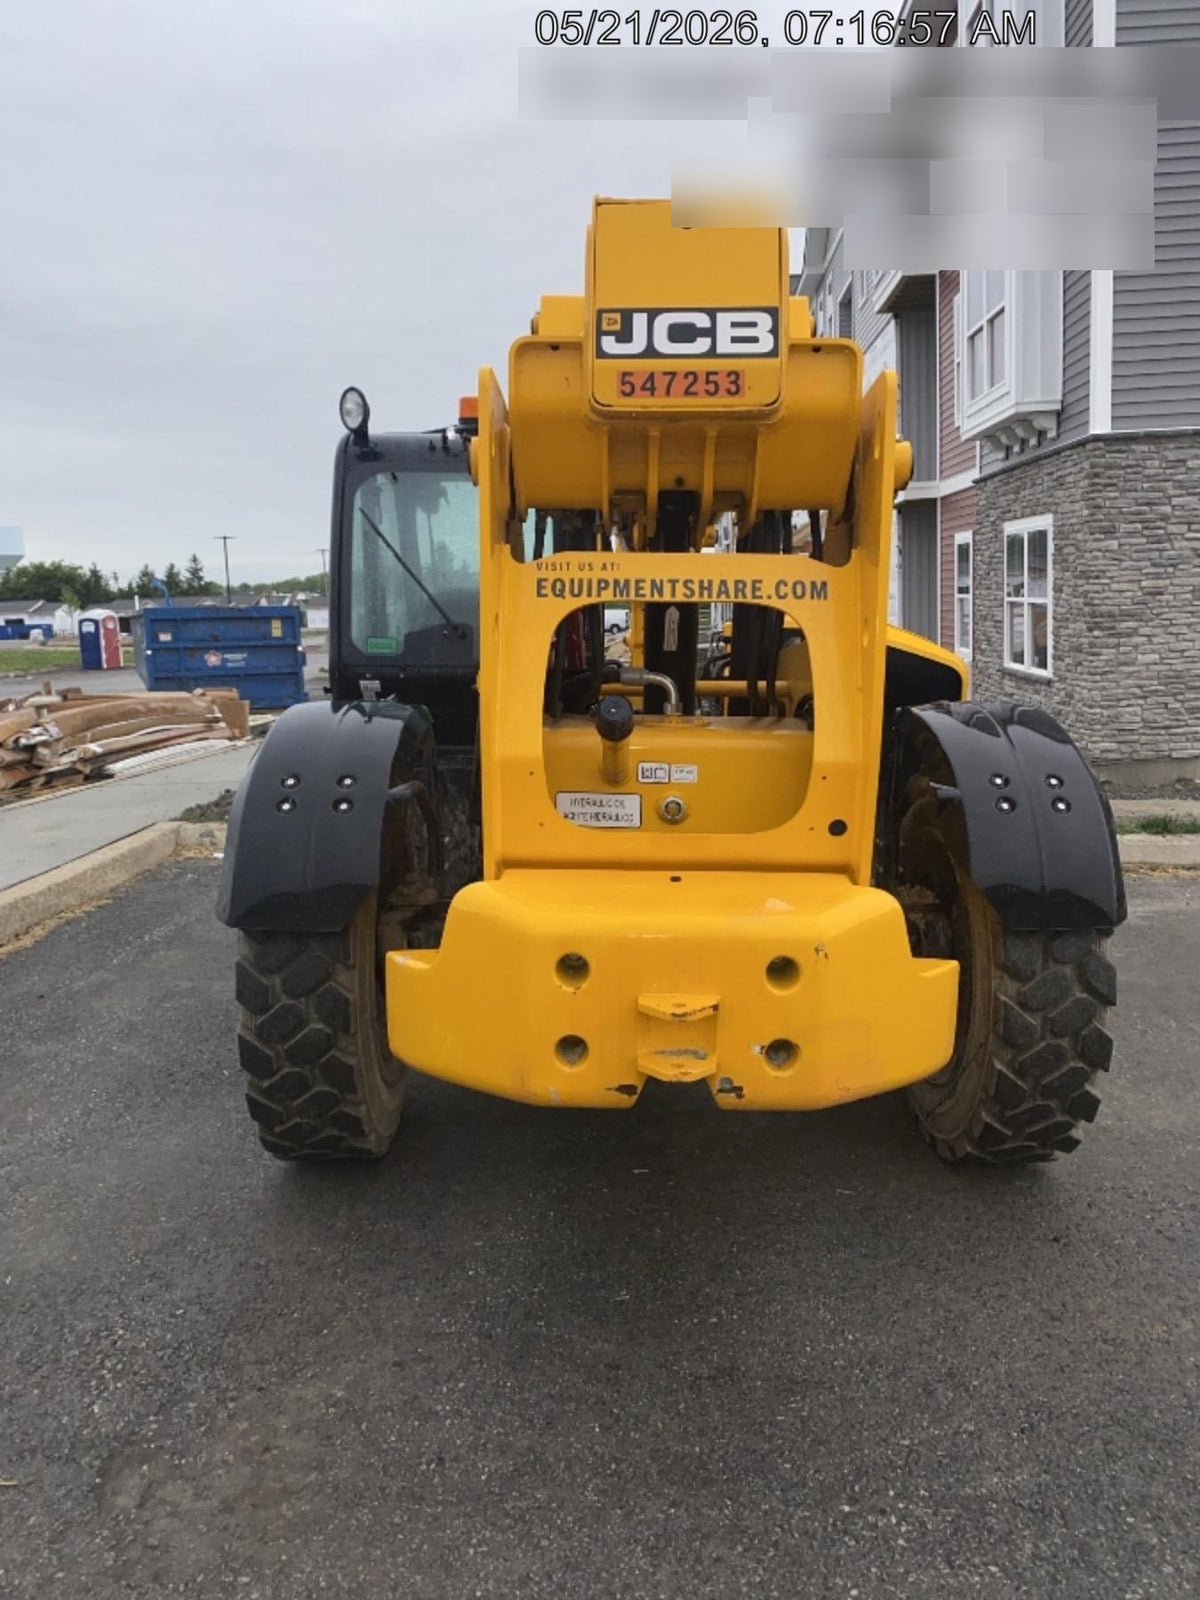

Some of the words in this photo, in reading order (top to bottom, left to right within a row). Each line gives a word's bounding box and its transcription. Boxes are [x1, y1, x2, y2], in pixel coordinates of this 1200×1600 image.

[600, 311, 775, 355] JCB
[620, 370, 741, 397] 547253
[536, 562, 571, 571] VISIT
[578, 562, 594, 571] US
[536, 577, 828, 601] EQUIPMENTSHARE.COM
